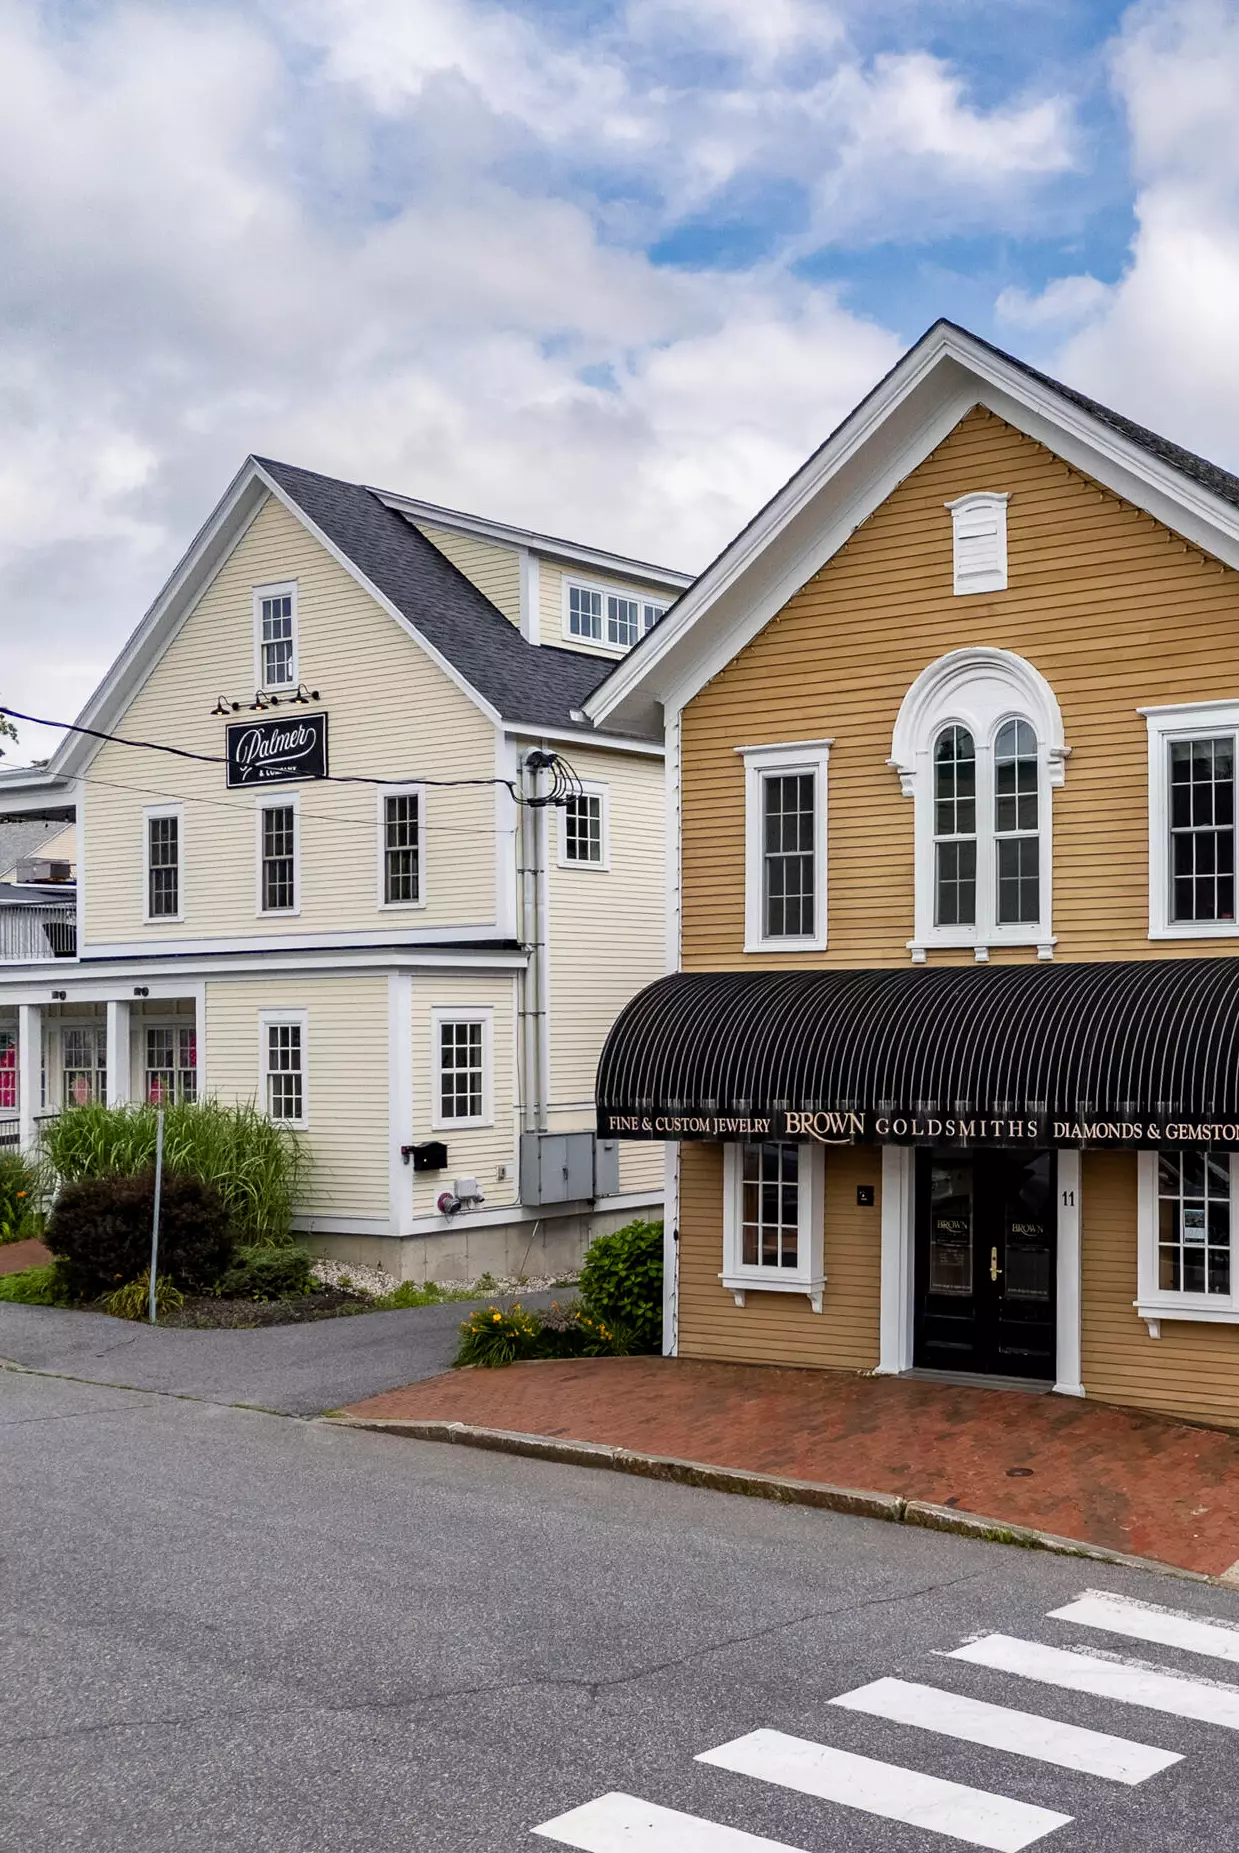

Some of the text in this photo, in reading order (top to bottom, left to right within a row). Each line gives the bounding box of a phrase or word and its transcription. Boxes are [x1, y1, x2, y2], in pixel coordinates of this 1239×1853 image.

[236, 724, 317, 780] Palmer
[609, 1116, 639, 1131] FINE
[641, 1116, 653, 1131] &
[655, 1117, 710, 1133] CUSTOM
[713, 1117, 771, 1134] JEWELRY
[785, 1111, 865, 1143] BROWN
[875, 1118, 1038, 1138] GOLDSMITHS
[1053, 1121, 1143, 1139] DIAMONDS
[1147, 1122, 1161, 1140] &
[1062, 1191, 1075, 1207] 11
[937, 1219, 968, 1233] BROWN
[1012, 1223, 1044, 1237] BROWN
